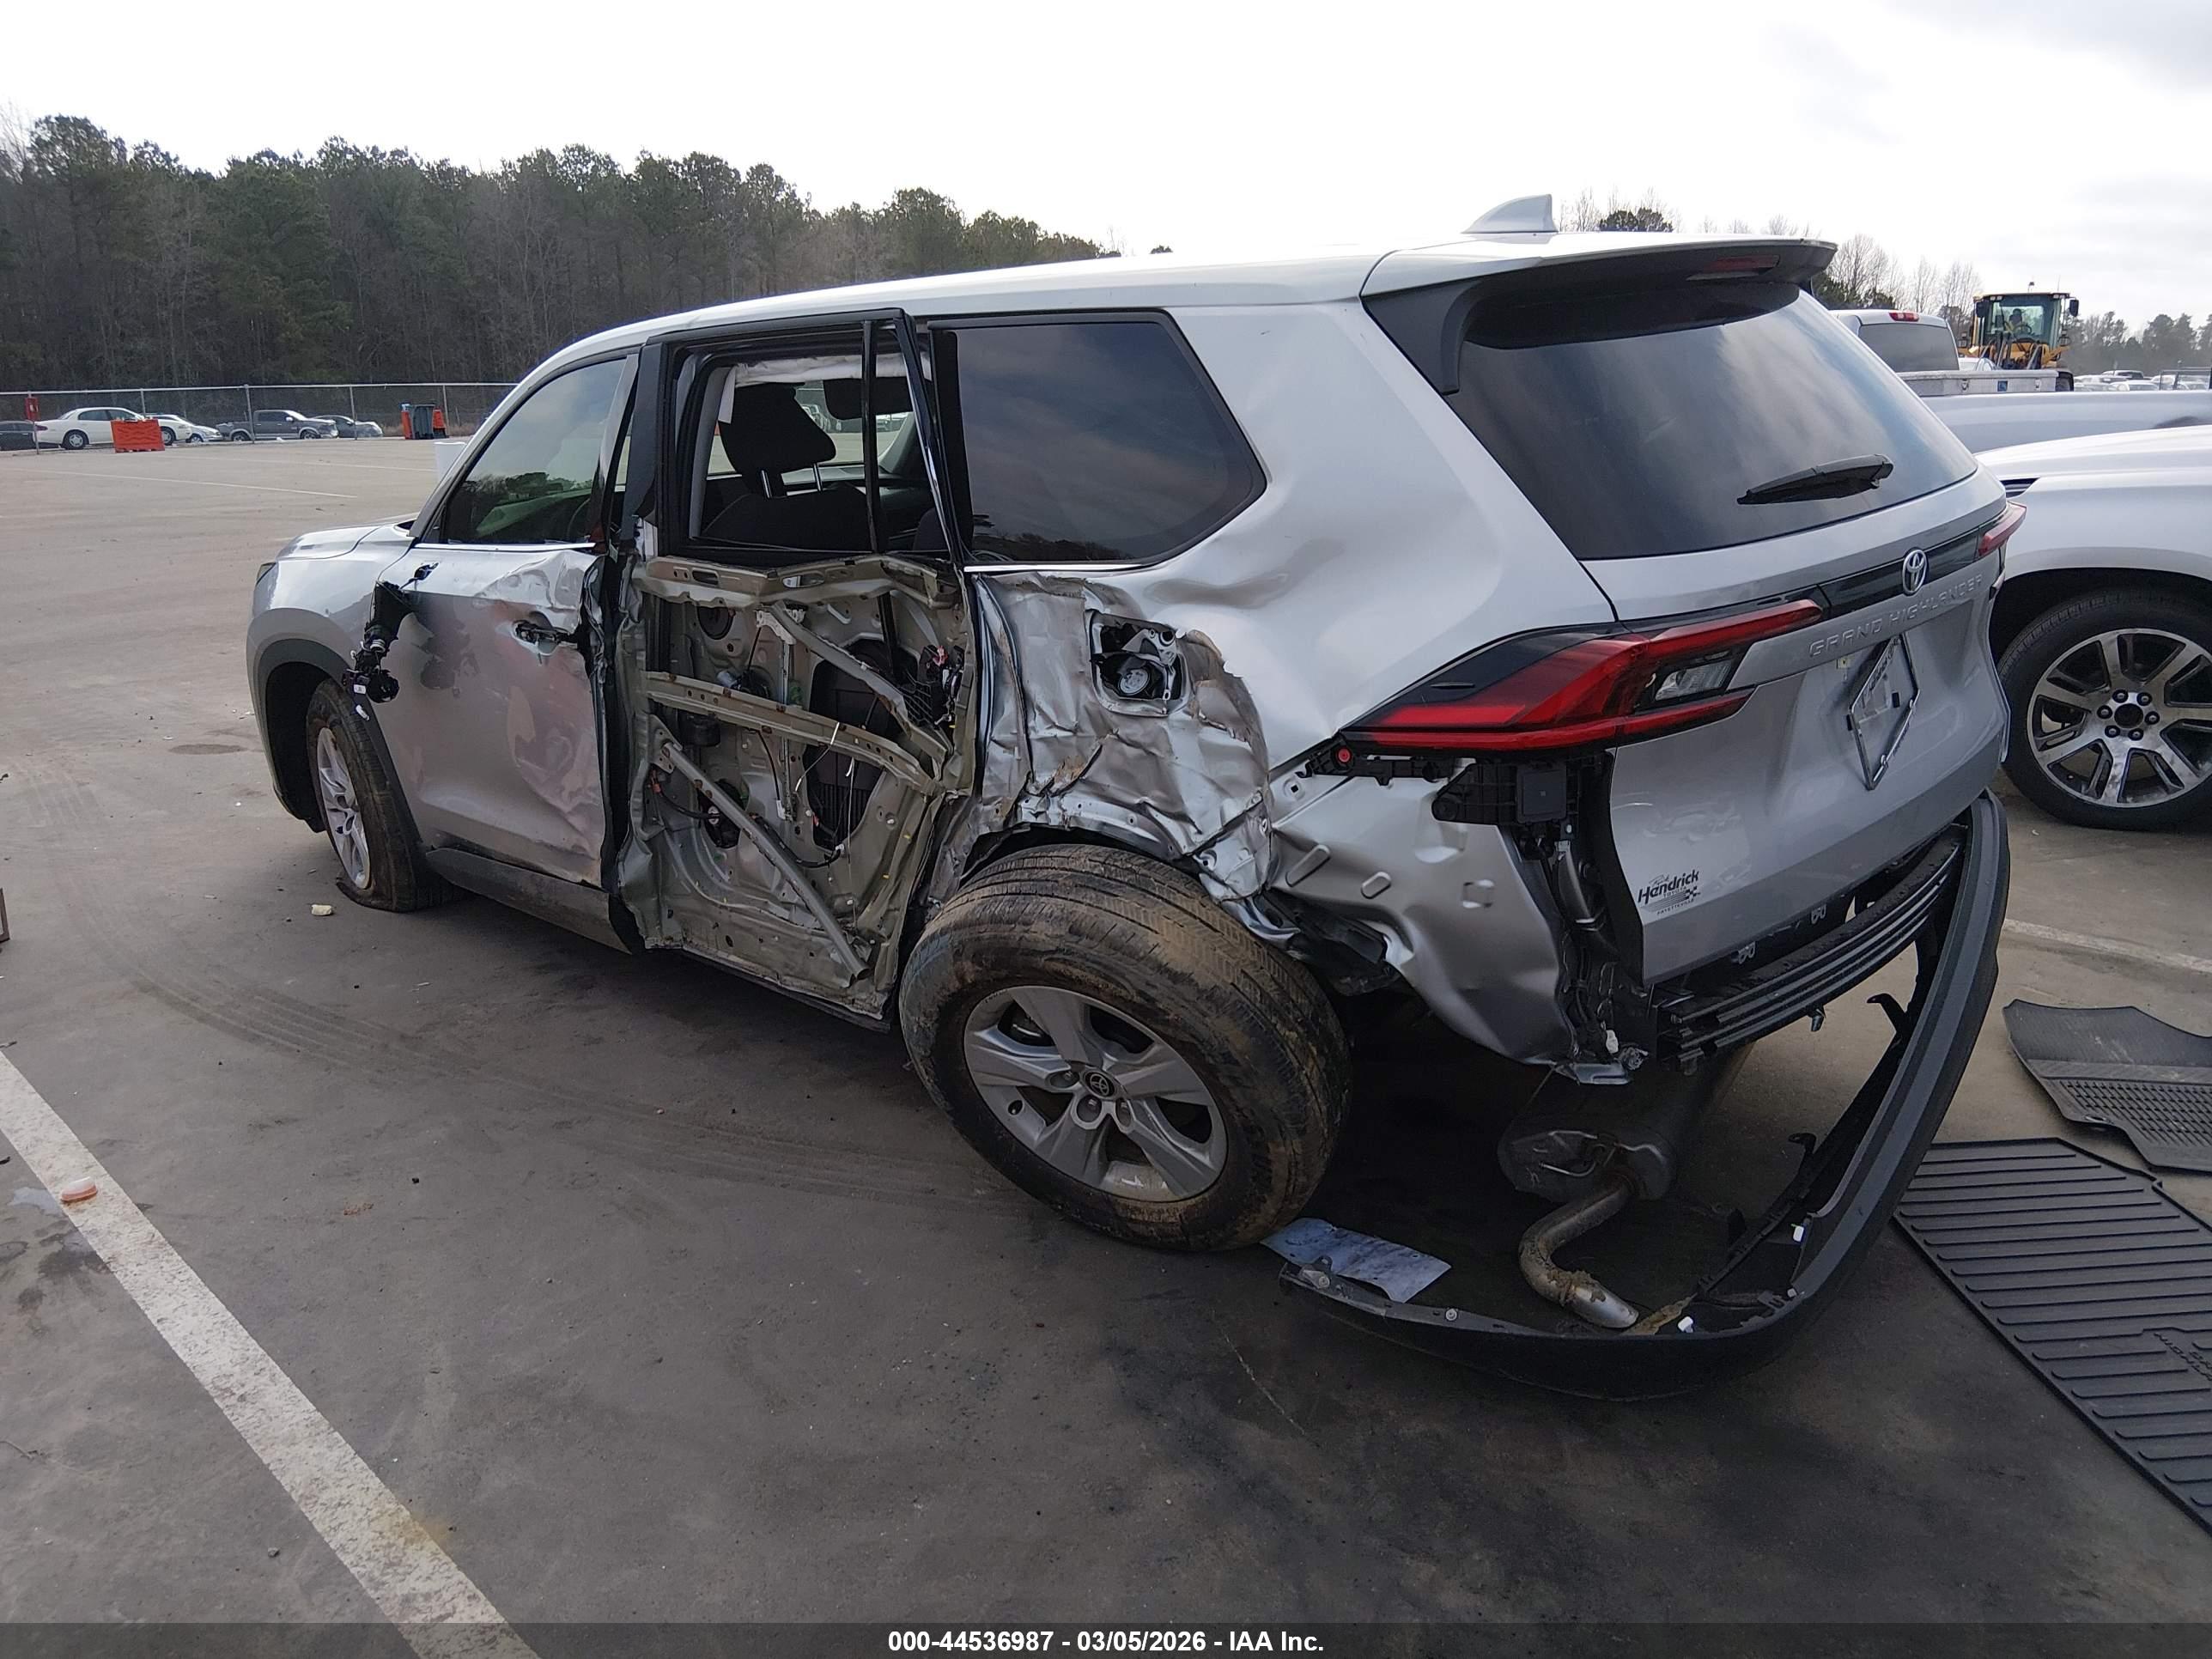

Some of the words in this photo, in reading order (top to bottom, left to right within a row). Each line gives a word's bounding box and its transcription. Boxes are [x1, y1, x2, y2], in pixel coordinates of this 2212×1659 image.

[1809, 618, 1883, 657] GRAND
[1889, 574, 1984, 623] HIGHLANDER
[1638, 869, 1699, 905] Hendrick
[1663, 886, 1686, 898] TOYOTA
